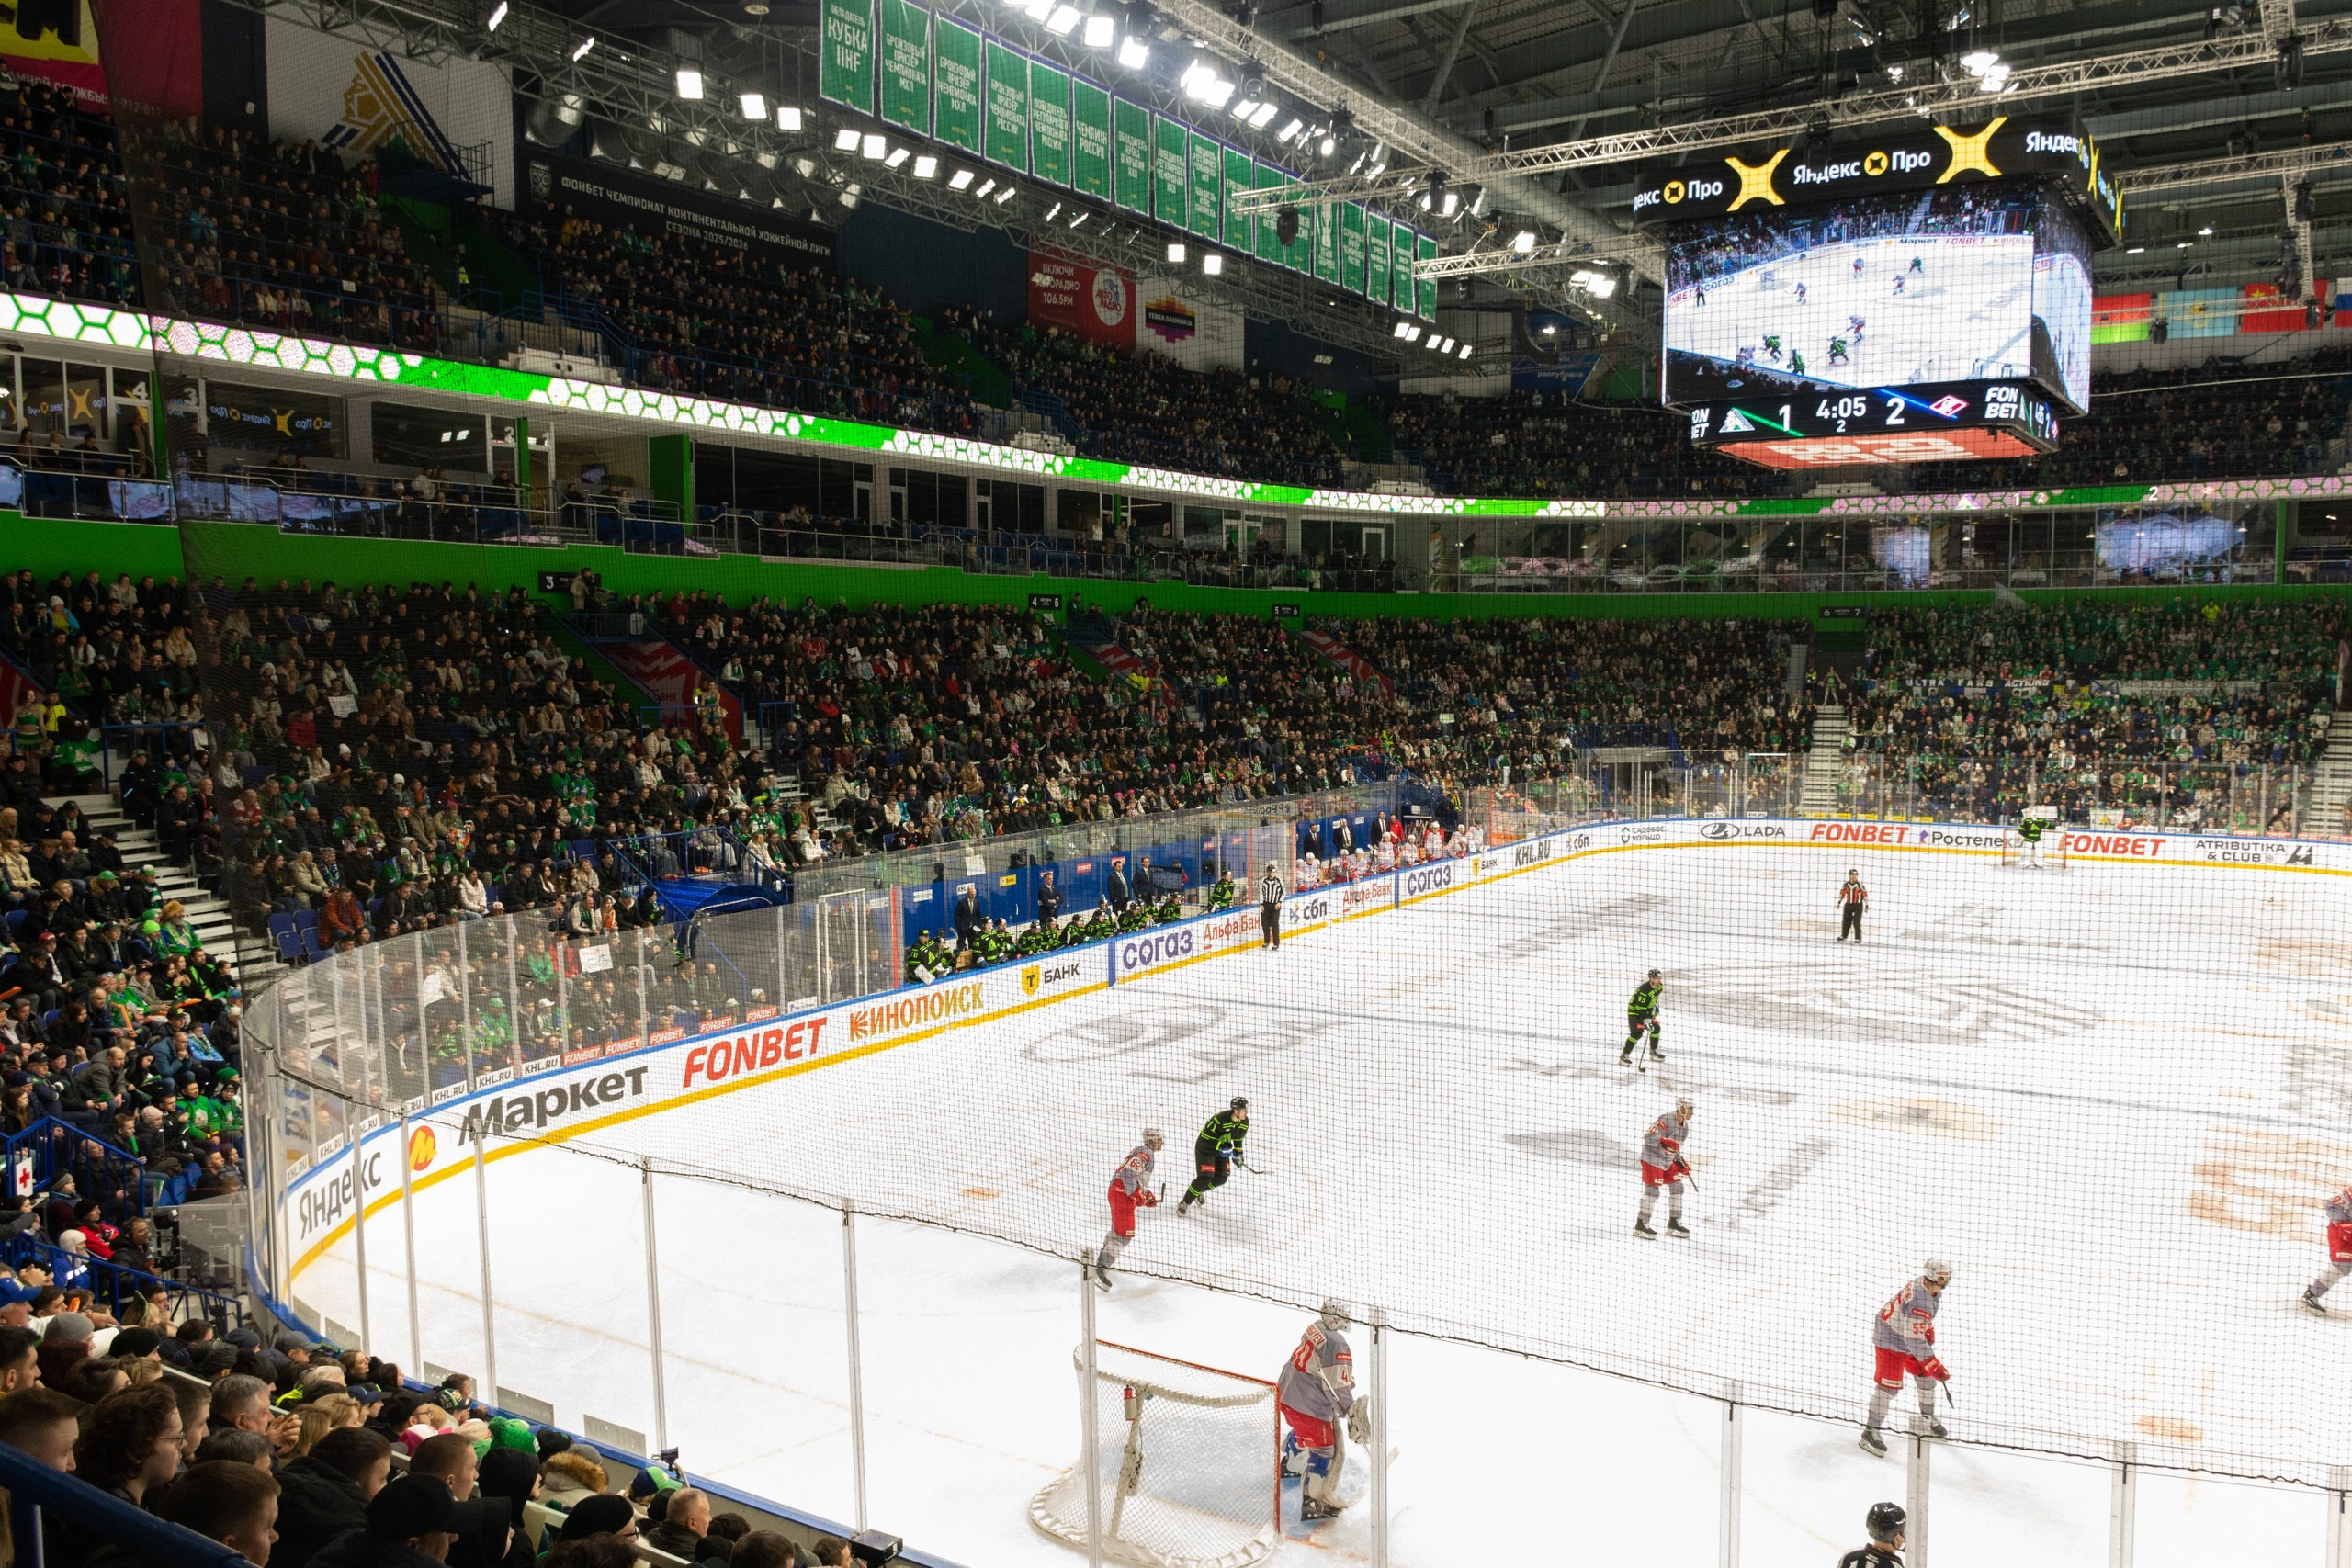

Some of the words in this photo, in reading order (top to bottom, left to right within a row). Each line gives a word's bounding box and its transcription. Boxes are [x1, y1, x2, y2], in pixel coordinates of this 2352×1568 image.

[827, 17, 867, 53] КУБКА
[837, 45, 861, 73] IIHF
[1793, 160, 1860, 185] Яндекс
[1892, 150, 1931, 171] Про
[1688, 179, 1723, 201] Про
[561, 175, 605, 197] ФОНБЕТ
[606, 188, 665, 214] ЧЕМПИОНАТ
[667, 205, 756, 239] КОНТИНЕНТАЛЬНОЙ
[758, 229, 808, 251] ХОККЕЙНОЙ
[809, 243, 831, 257] ЛИГИ
[666, 221, 700, 240] СЕЗОНА
[703, 231, 749, 251] 2025/2026
[1945, 237, 1985, 248] FONBET
[1043, 264, 1074, 276] ВКЛЮЧИ
[1096, 289, 1114, 302] АВТО
[1100, 298, 1121, 313] РАДИО
[132, 381, 148, 400] 4
[183, 387, 198, 406] 3
[1985, 386, 2018, 402] FON
[1815, 396, 1867, 420] 4:05
[1885, 398, 1905, 425] 2
[1984, 403, 2018, 419] BET
[1779, 405, 1791, 433] 1
[1836, 421, 1846, 433] 2
[504, 425, 515, 441] 2
[2149, 486, 2159, 501] 2
[545, 575, 554, 590] 3
[1032, 596, 1037, 607] 4
[1054, 597, 1059, 608] 5
[1293, 606, 1298, 615] 6
[1824, 608, 1830, 616] 6
[1854, 608, 1861, 616] 7
[1905, 678, 1946, 688] ULTRA
[1744, 826, 1786, 837] LADA
[1810, 823, 1909, 844] FONBET
[2058, 834, 2166, 856] FONBET
[2196, 840, 2287, 852] ATRIBUTIKA
[1515, 840, 1551, 868] KHL.RU
[2207, 852, 2217, 861] &
[2222, 853, 2261, 863] CLUB
[1044, 963, 1080, 984] БАНК
[747, 1007, 777, 1022] FONBET
[850, 981, 984, 1042] КИНОПОИСК
[700, 1017, 732, 1034] FONBET
[650, 1029, 684, 1045] FONBET
[605, 1037, 641, 1055] FONBET
[683, 1016, 828, 1089] FONBET
[563, 1047, 601, 1066] FONBET
[525, 1058, 558, 1075] KHL.RU
[479, 1069, 512, 1088] KHL.RU
[434, 1084, 466, 1102] KHL.RU
[299, 1151, 381, 1240] Яндекс
[458, 1065, 649, 1147] Маркет
[320, 1136, 343, 1159] KHL.RU
[1913, 1323, 1926, 1336] 55
